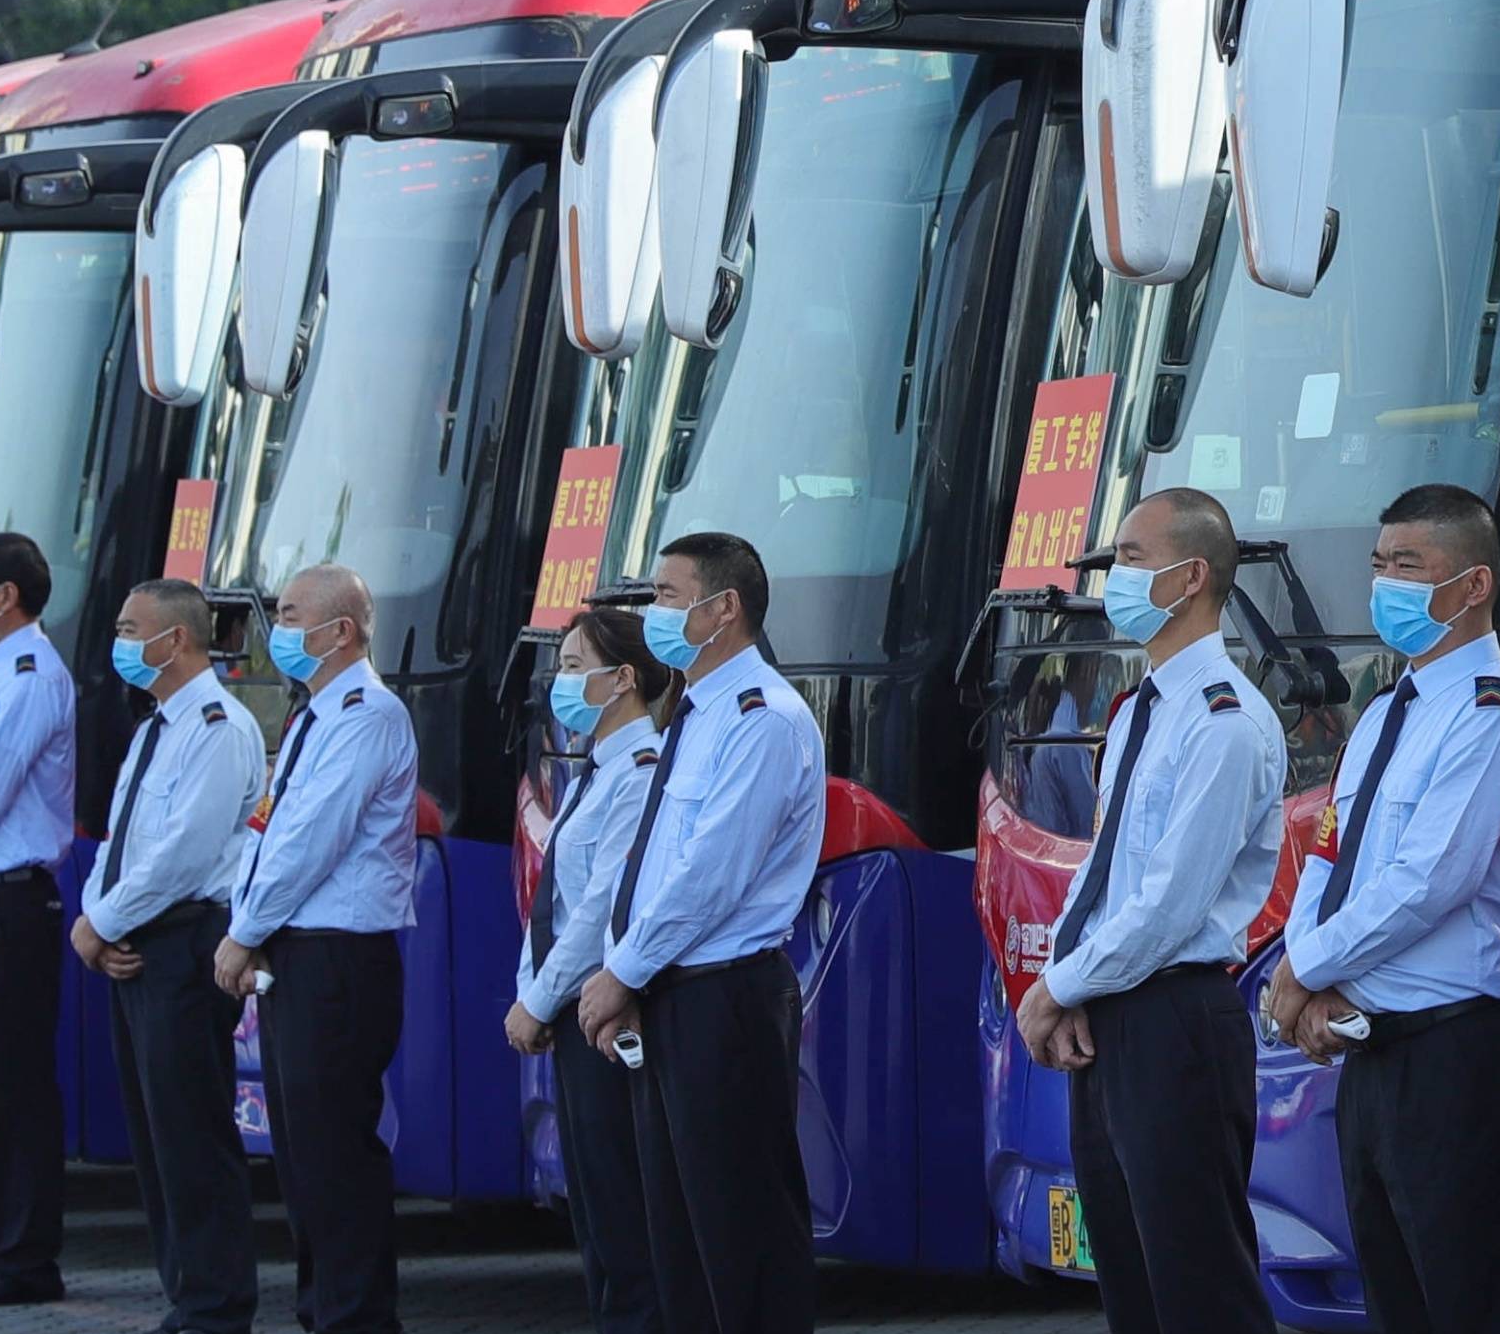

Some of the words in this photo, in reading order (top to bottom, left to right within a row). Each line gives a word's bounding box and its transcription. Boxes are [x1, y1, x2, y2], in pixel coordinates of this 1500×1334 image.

[1026, 411, 1102, 476] 复工专线
[1007, 506, 1086, 568] 放心出行
